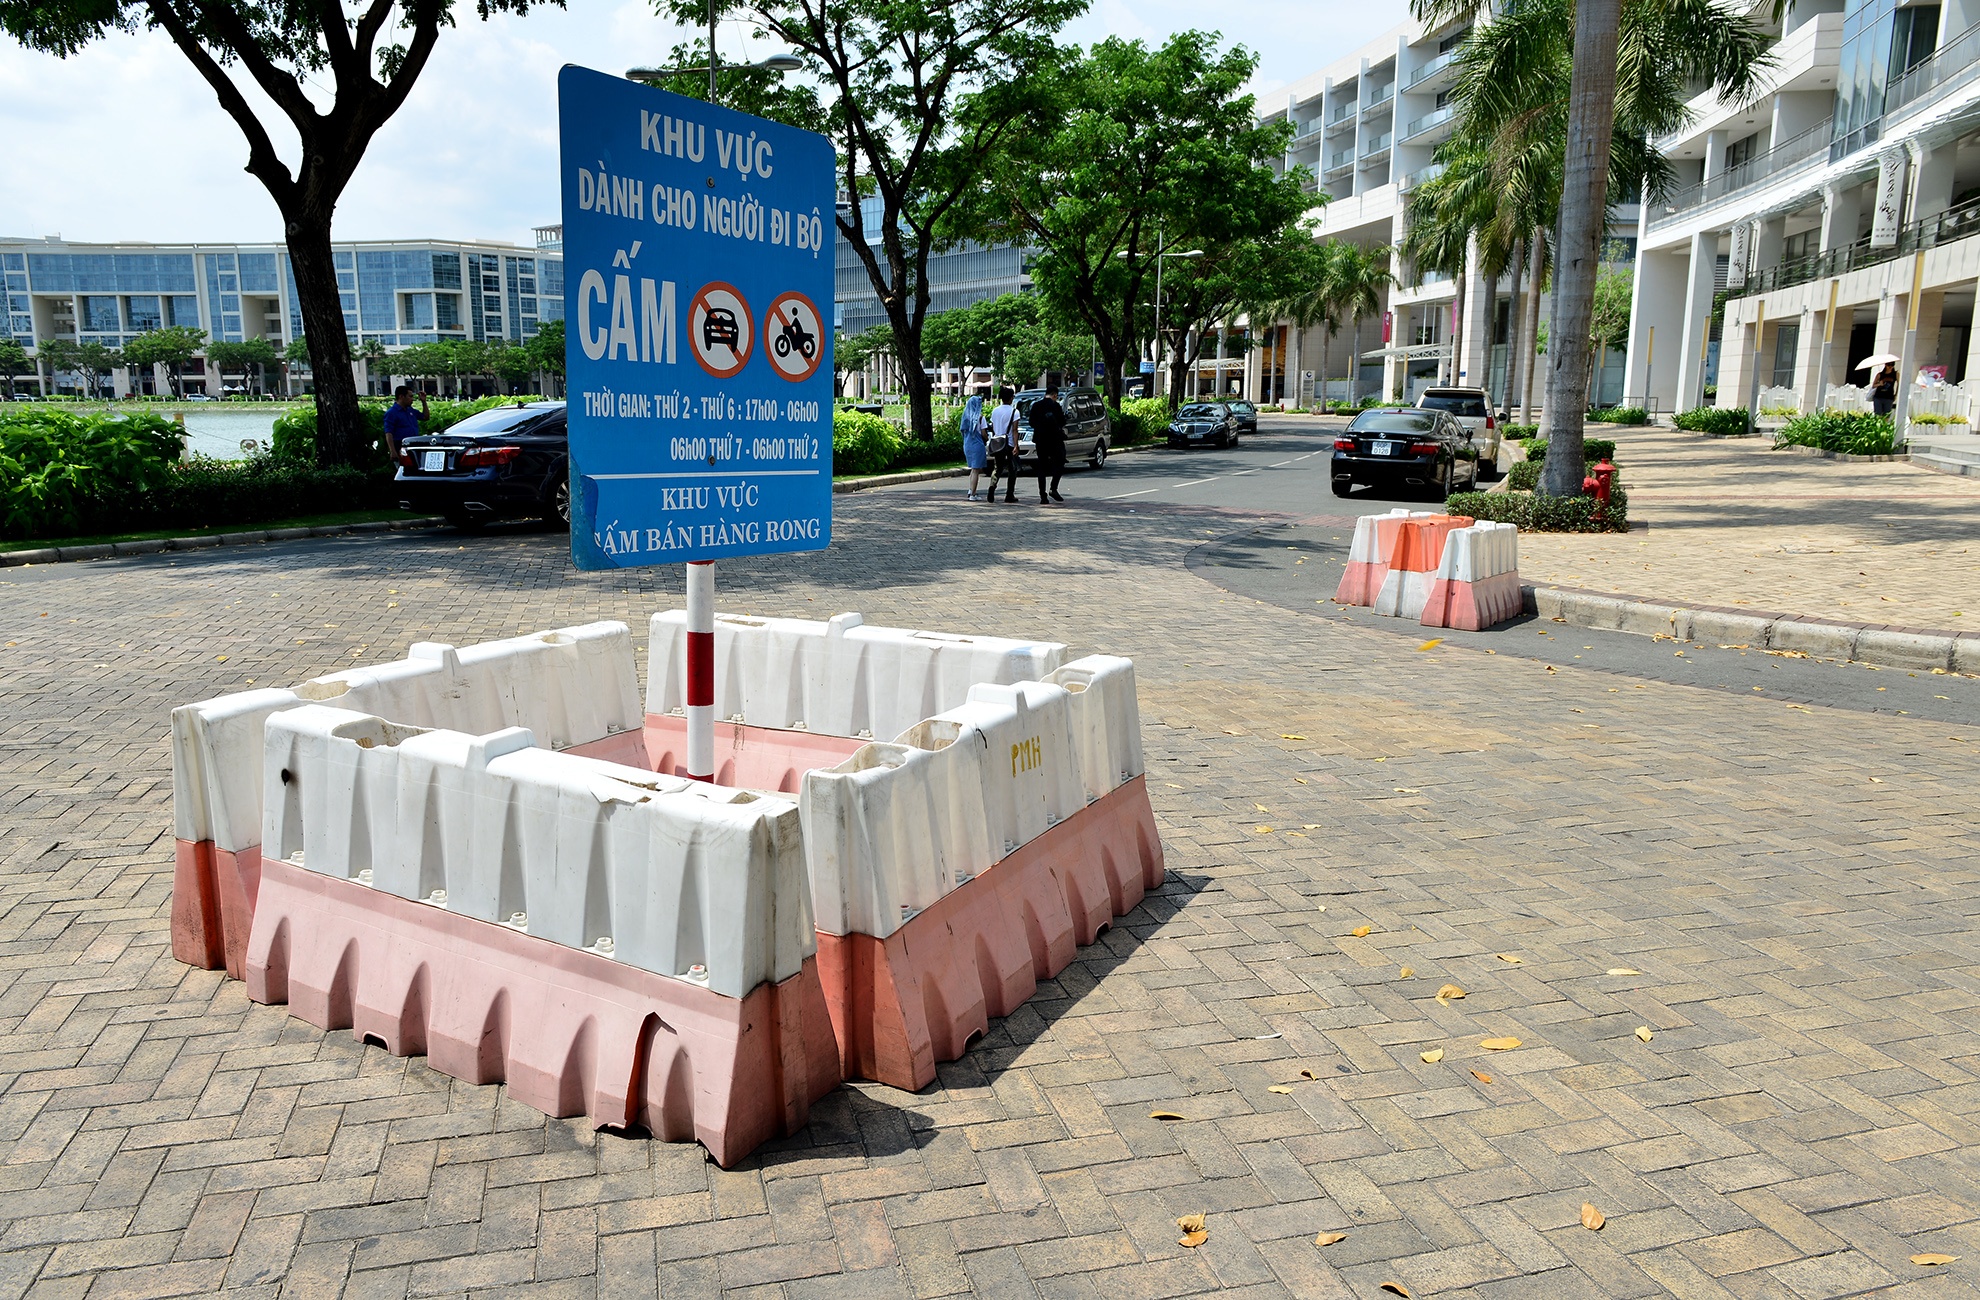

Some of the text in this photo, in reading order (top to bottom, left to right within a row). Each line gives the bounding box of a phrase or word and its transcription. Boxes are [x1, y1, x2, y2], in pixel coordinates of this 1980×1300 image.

[640, 108, 774, 182] KHU VỰC
[578, 160, 823, 259] DÀNH CHO NGƯỜI ĐI BỘ
[578, 240, 677, 364] CẤM
[583, 386, 615, 418] THỜI
[618, 393, 651, 418] GIAN:
[654, 389, 680, 419] THỨ
[682, 396, 690, 419] 2
[701, 391, 725, 420] THỨ
[727, 398, 735, 421] 6
[745, 399, 778, 421] 17h00
[787, 400, 819, 422] 06h00
[670, 437, 707, 461] 06h00
[709, 432, 733, 460] THỨ
[735, 438, 743, 460] 7
[752, 438, 785, 460] 06h00
[788, 433, 810, 460] THỨ
[811, 438, 818, 460] 2
[661, 481, 759, 513] KHU VỰC
[646, 520, 694, 552] BÁN
[699, 517, 760, 547] HÀNG
[765, 517, 820, 543] RONG
[1011, 735, 1041, 778] PMH
